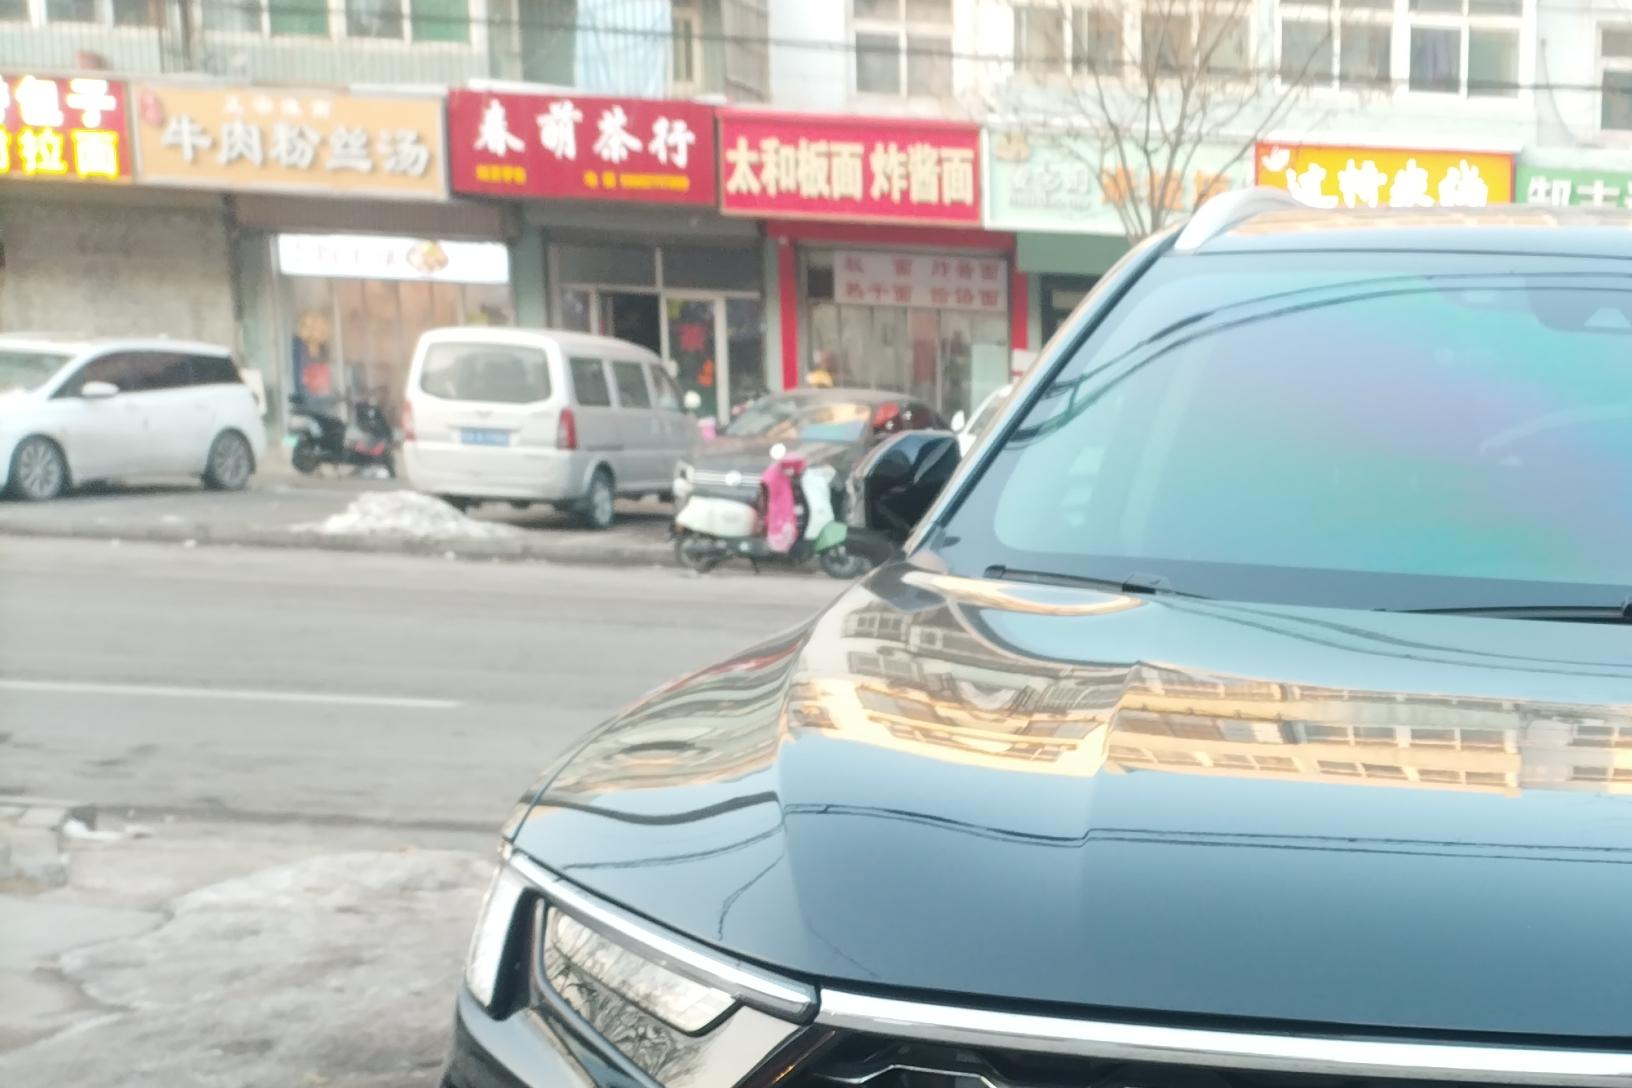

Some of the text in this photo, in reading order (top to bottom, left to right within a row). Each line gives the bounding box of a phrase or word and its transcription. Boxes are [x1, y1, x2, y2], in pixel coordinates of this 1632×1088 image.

[160, 115, 431, 177] 牛肉粉丝汤
[726, 136, 865, 203] 太和板面
[869, 141, 976, 207] 炸酱面
